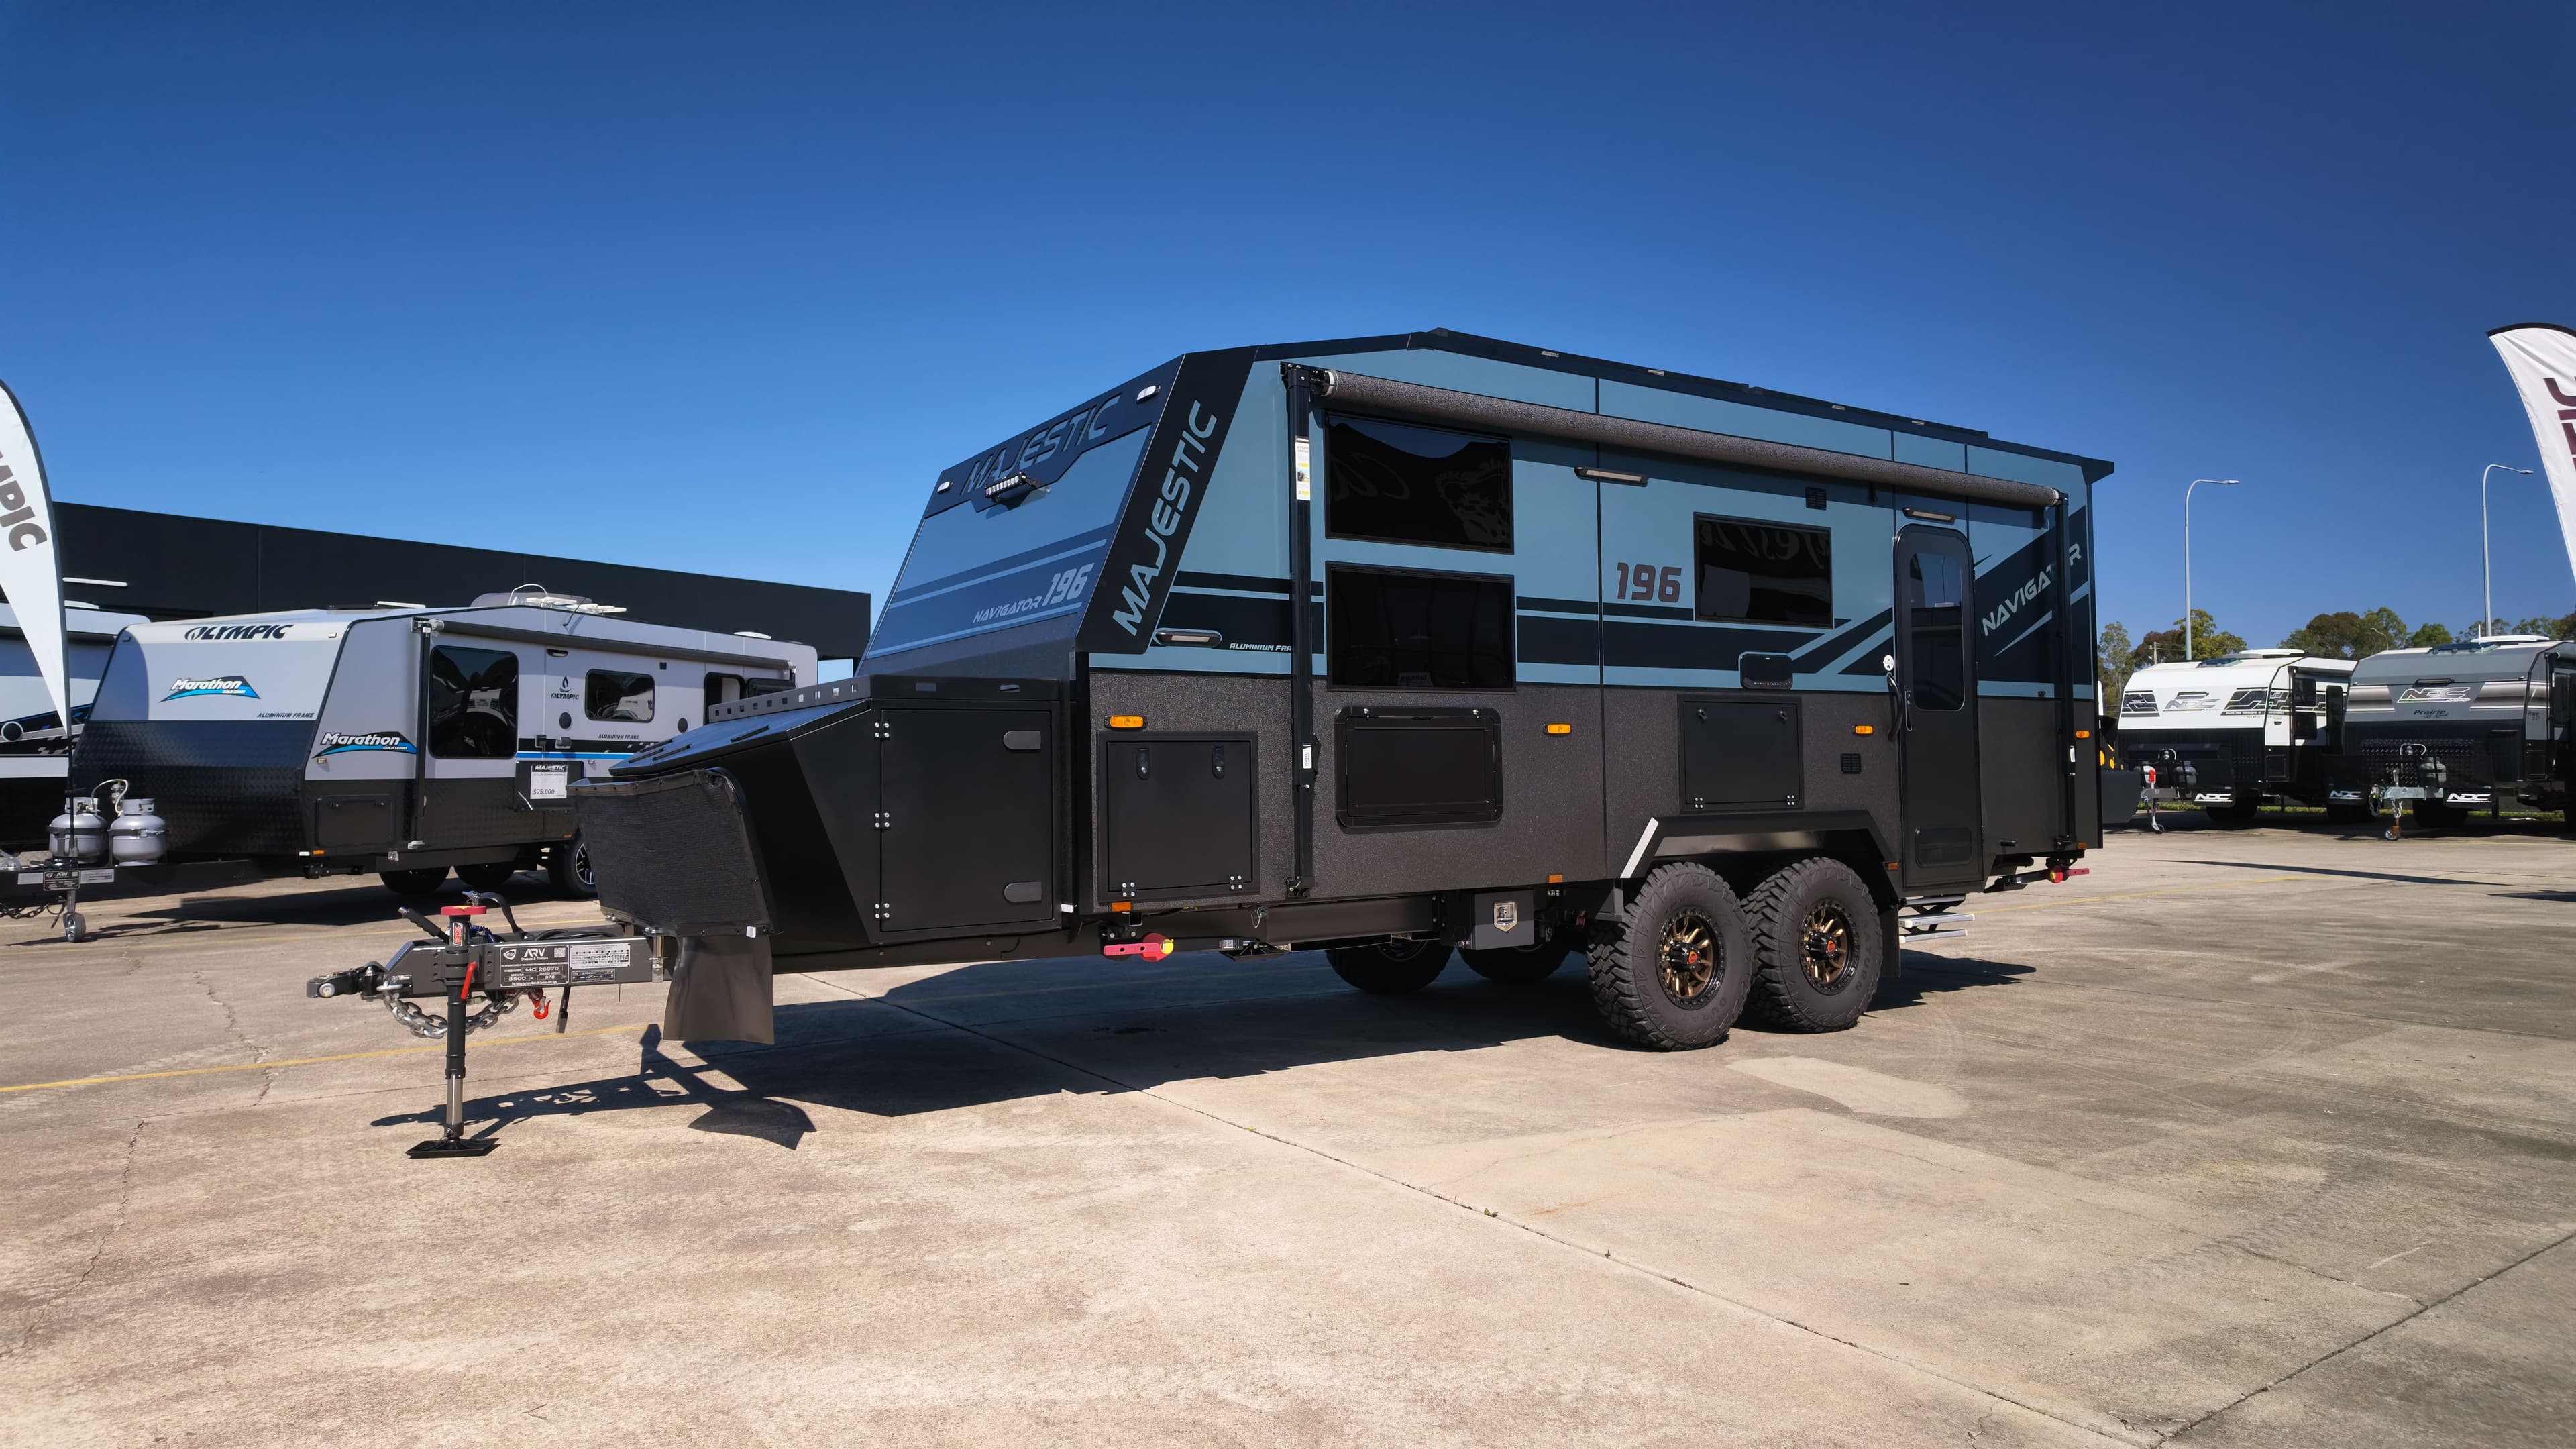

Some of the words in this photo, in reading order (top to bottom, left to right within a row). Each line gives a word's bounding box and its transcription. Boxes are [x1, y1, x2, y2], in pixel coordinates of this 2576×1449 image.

[959, 393, 1122, 495] MAJESTIC
[1112, 400, 1217, 636] MAJESTIC
[973, 596, 1042, 623] NAVIGATOR
[1042, 563, 1095, 607] 196
[1617, 562, 1682, 603] 196
[1982, 543, 2082, 637] NAVIGAR
[184, 624, 295, 641] OLYMPIC
[170, 678, 242, 690] Marathon
[321, 733, 400, 745] Marathon
[524, 948, 545, 957] ARV
